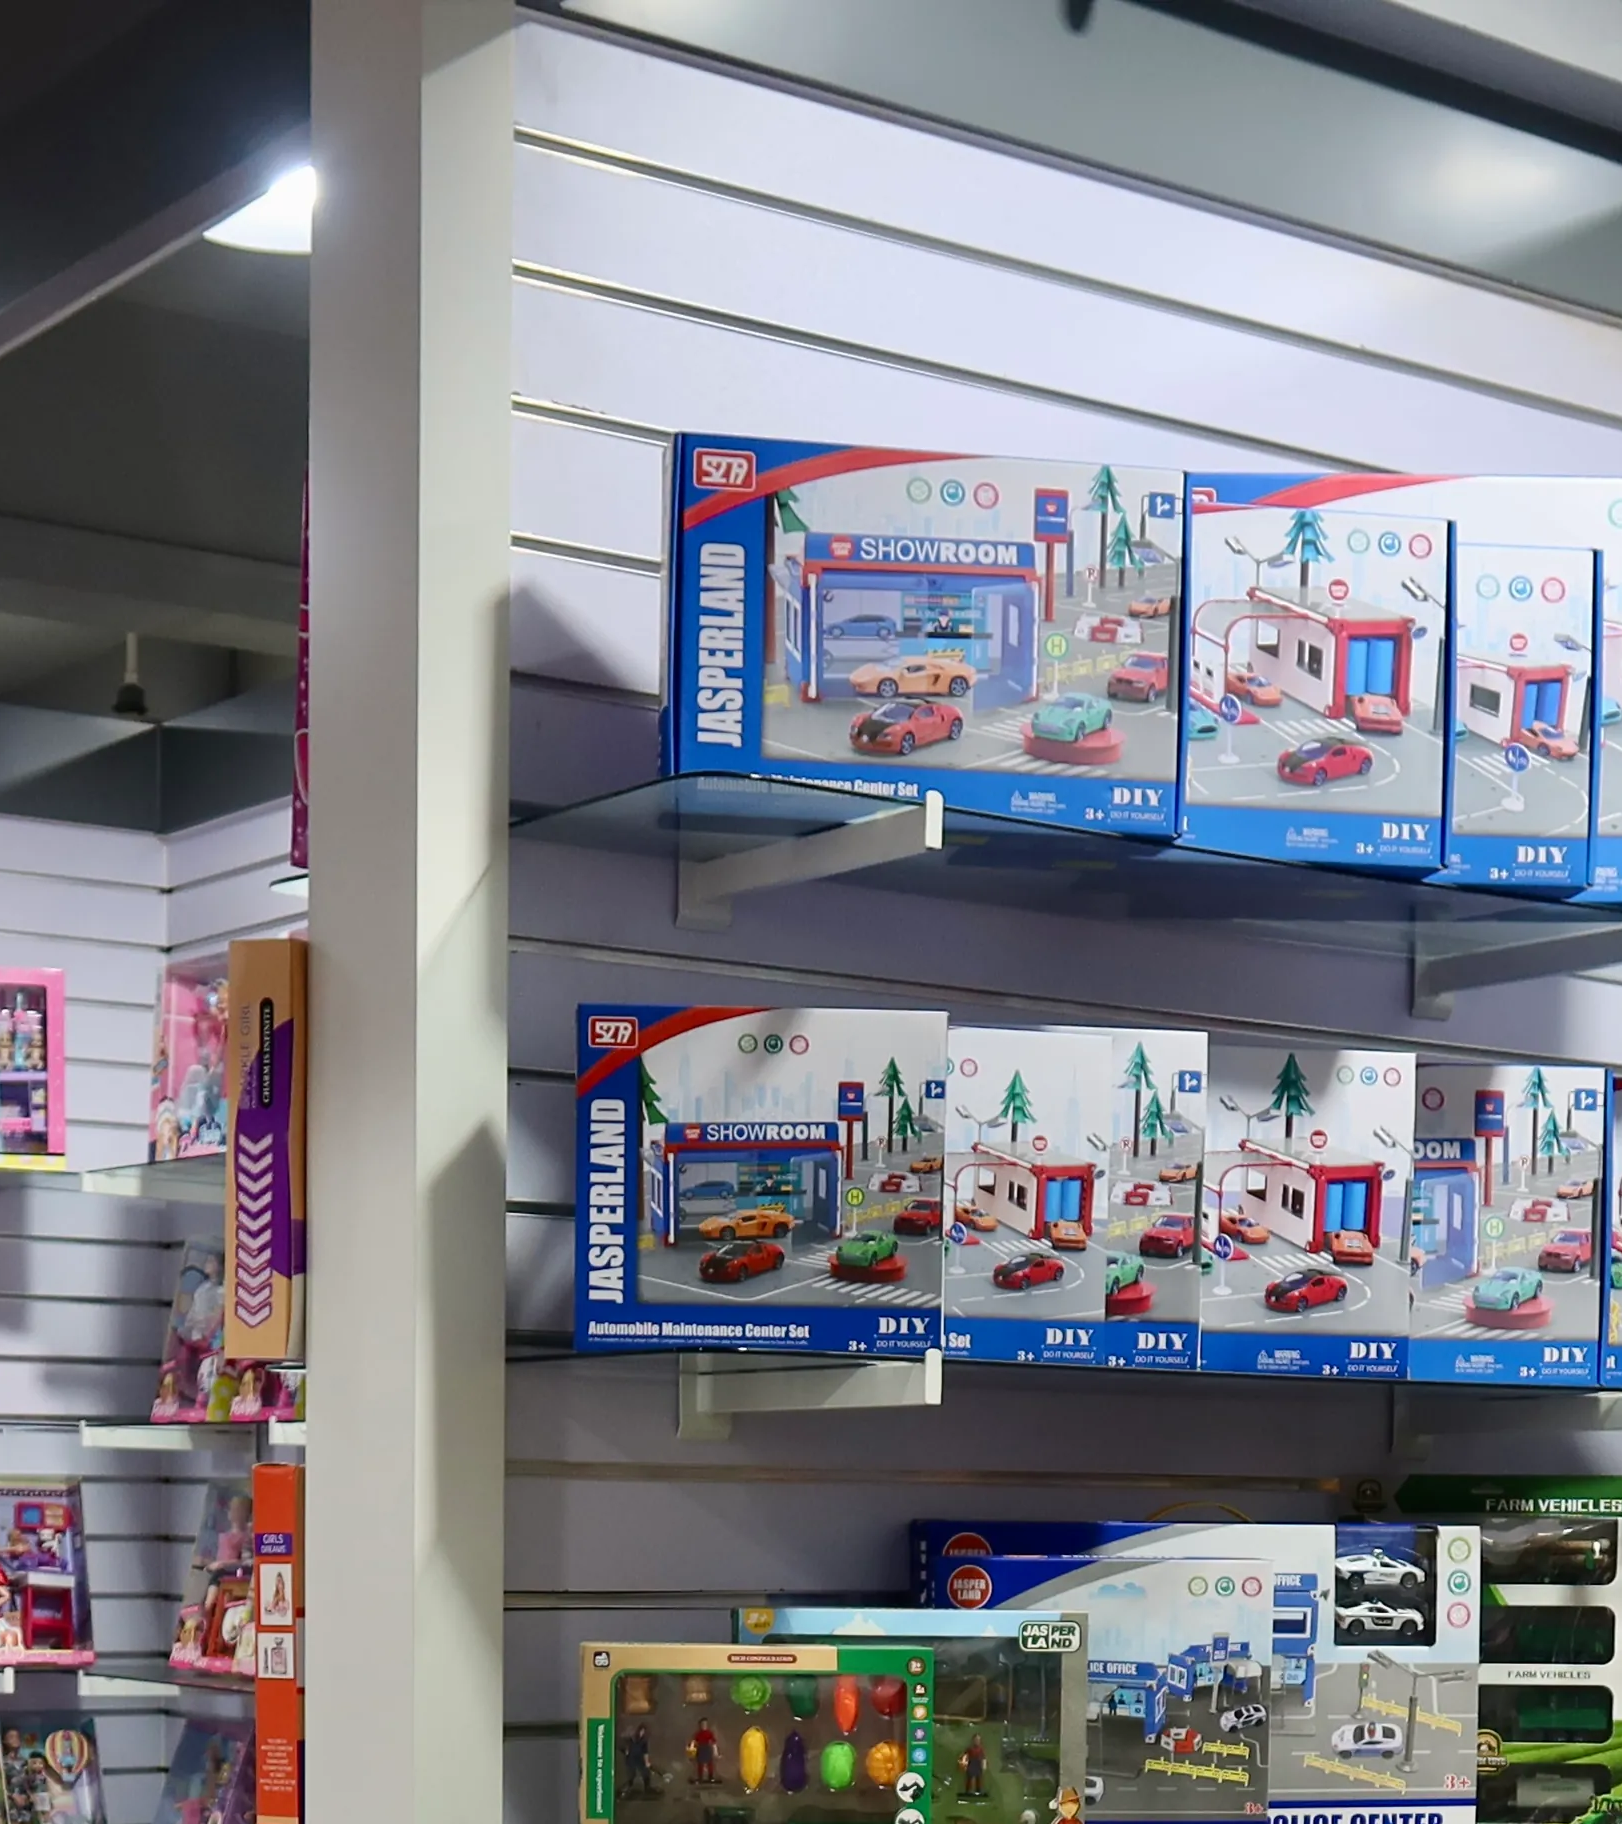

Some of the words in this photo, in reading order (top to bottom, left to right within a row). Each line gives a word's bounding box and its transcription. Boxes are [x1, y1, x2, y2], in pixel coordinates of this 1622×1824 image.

[859, 537, 1019, 567] SHOWROOM
[697, 544, 747, 749] JASPERLAND
[1382, 822, 1431, 842] DIY
[262, 1009, 271, 1051] INFINITE
[262, 1052, 271, 1064] IS
[262, 1065, 271, 1104] CHARM
[706, 1123, 826, 1142] SHOWROOM
[588, 1098, 626, 1305] JASPERLAND
[588, 1320, 660, 1338] Automobile
[661, 1322, 742, 1338] Maintenance
[745, 1323, 787, 1339] Center
[789, 1324, 810, 1339] Set
[878, 1317, 930, 1335] DIY
[949, 1332, 971, 1349] Set
[1136, 1332, 1189, 1350] DIY
[1543, 1346, 1588, 1364] DIY
[1485, 1499, 1534, 1513] FARM
[262, 1533, 284, 1545] GIRLS
[953, 1579, 987, 1590] JASPER
[957, 1590, 982, 1601] LAND
[1023, 1624, 1077, 1637] JASPER
[1026, 1636, 1073, 1649] LAND
[1106, 1661, 1137, 1675] OFFICE
[1507, 1671, 1537, 1680] FARM
[1539, 1670, 1592, 1680] VEHICLES
[1445, 1775, 1471, 1790] 3+
